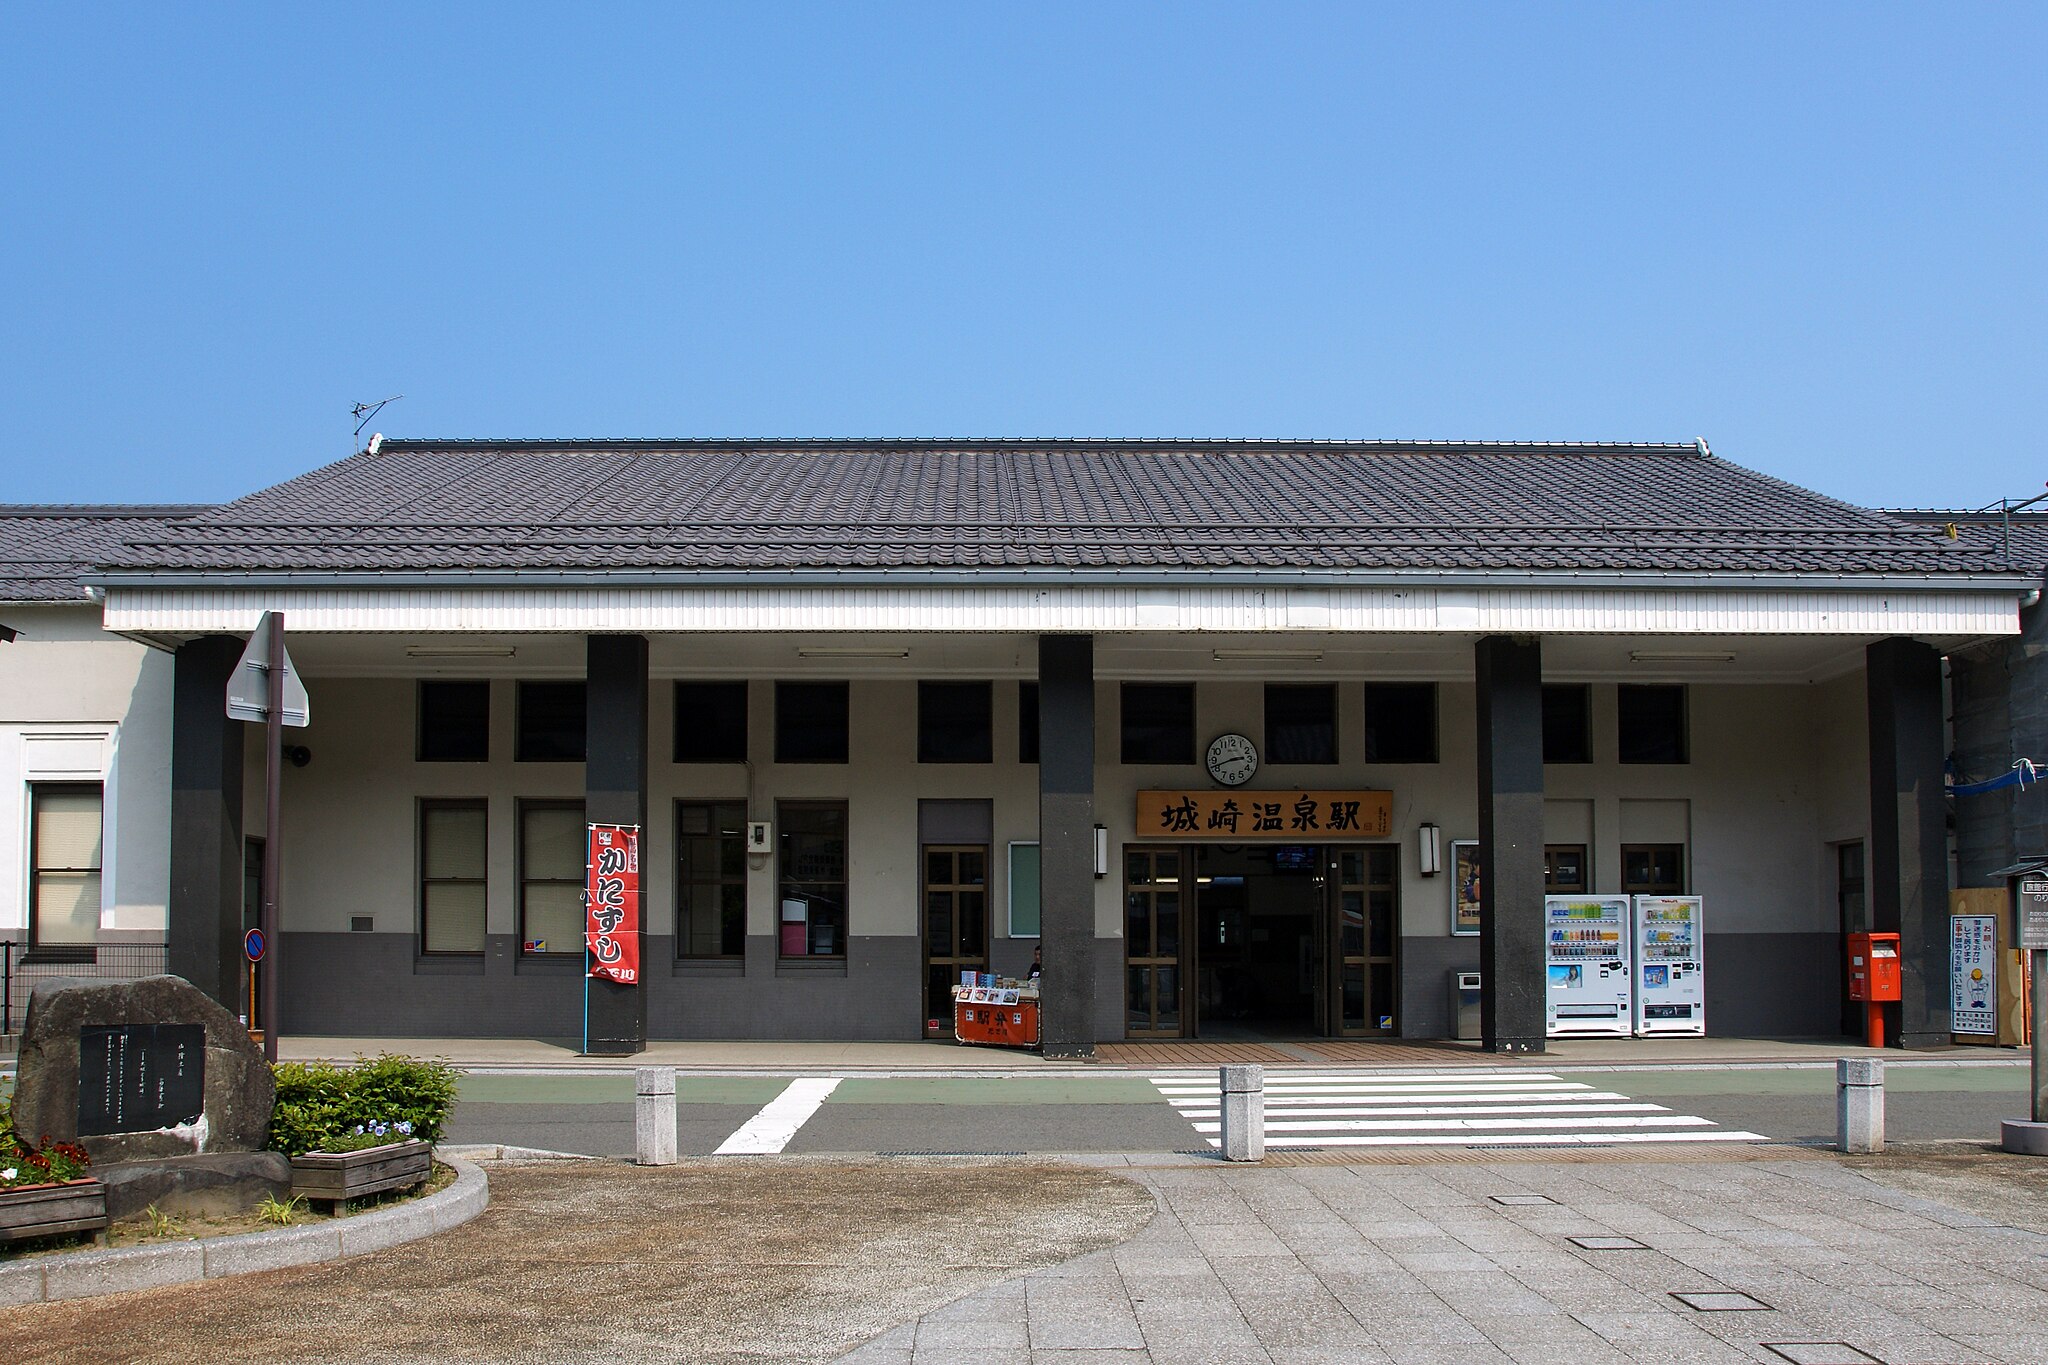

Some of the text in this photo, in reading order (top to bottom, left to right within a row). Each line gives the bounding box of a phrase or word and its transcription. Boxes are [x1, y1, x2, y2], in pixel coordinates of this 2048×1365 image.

[1220, 741, 1227, 749] 11
[1212, 747, 1222, 756] 10
[1244, 747, 1250, 755] 2
[1211, 756, 1217, 764] 9
[1246, 755, 1253, 763] 3
[1244, 764, 1250, 772] 4
[1160, 794, 1361, 834] 城崎温泉駅
[592, 848, 627, 964] かにずし
[1983, 925, 1992, 951] お願い
